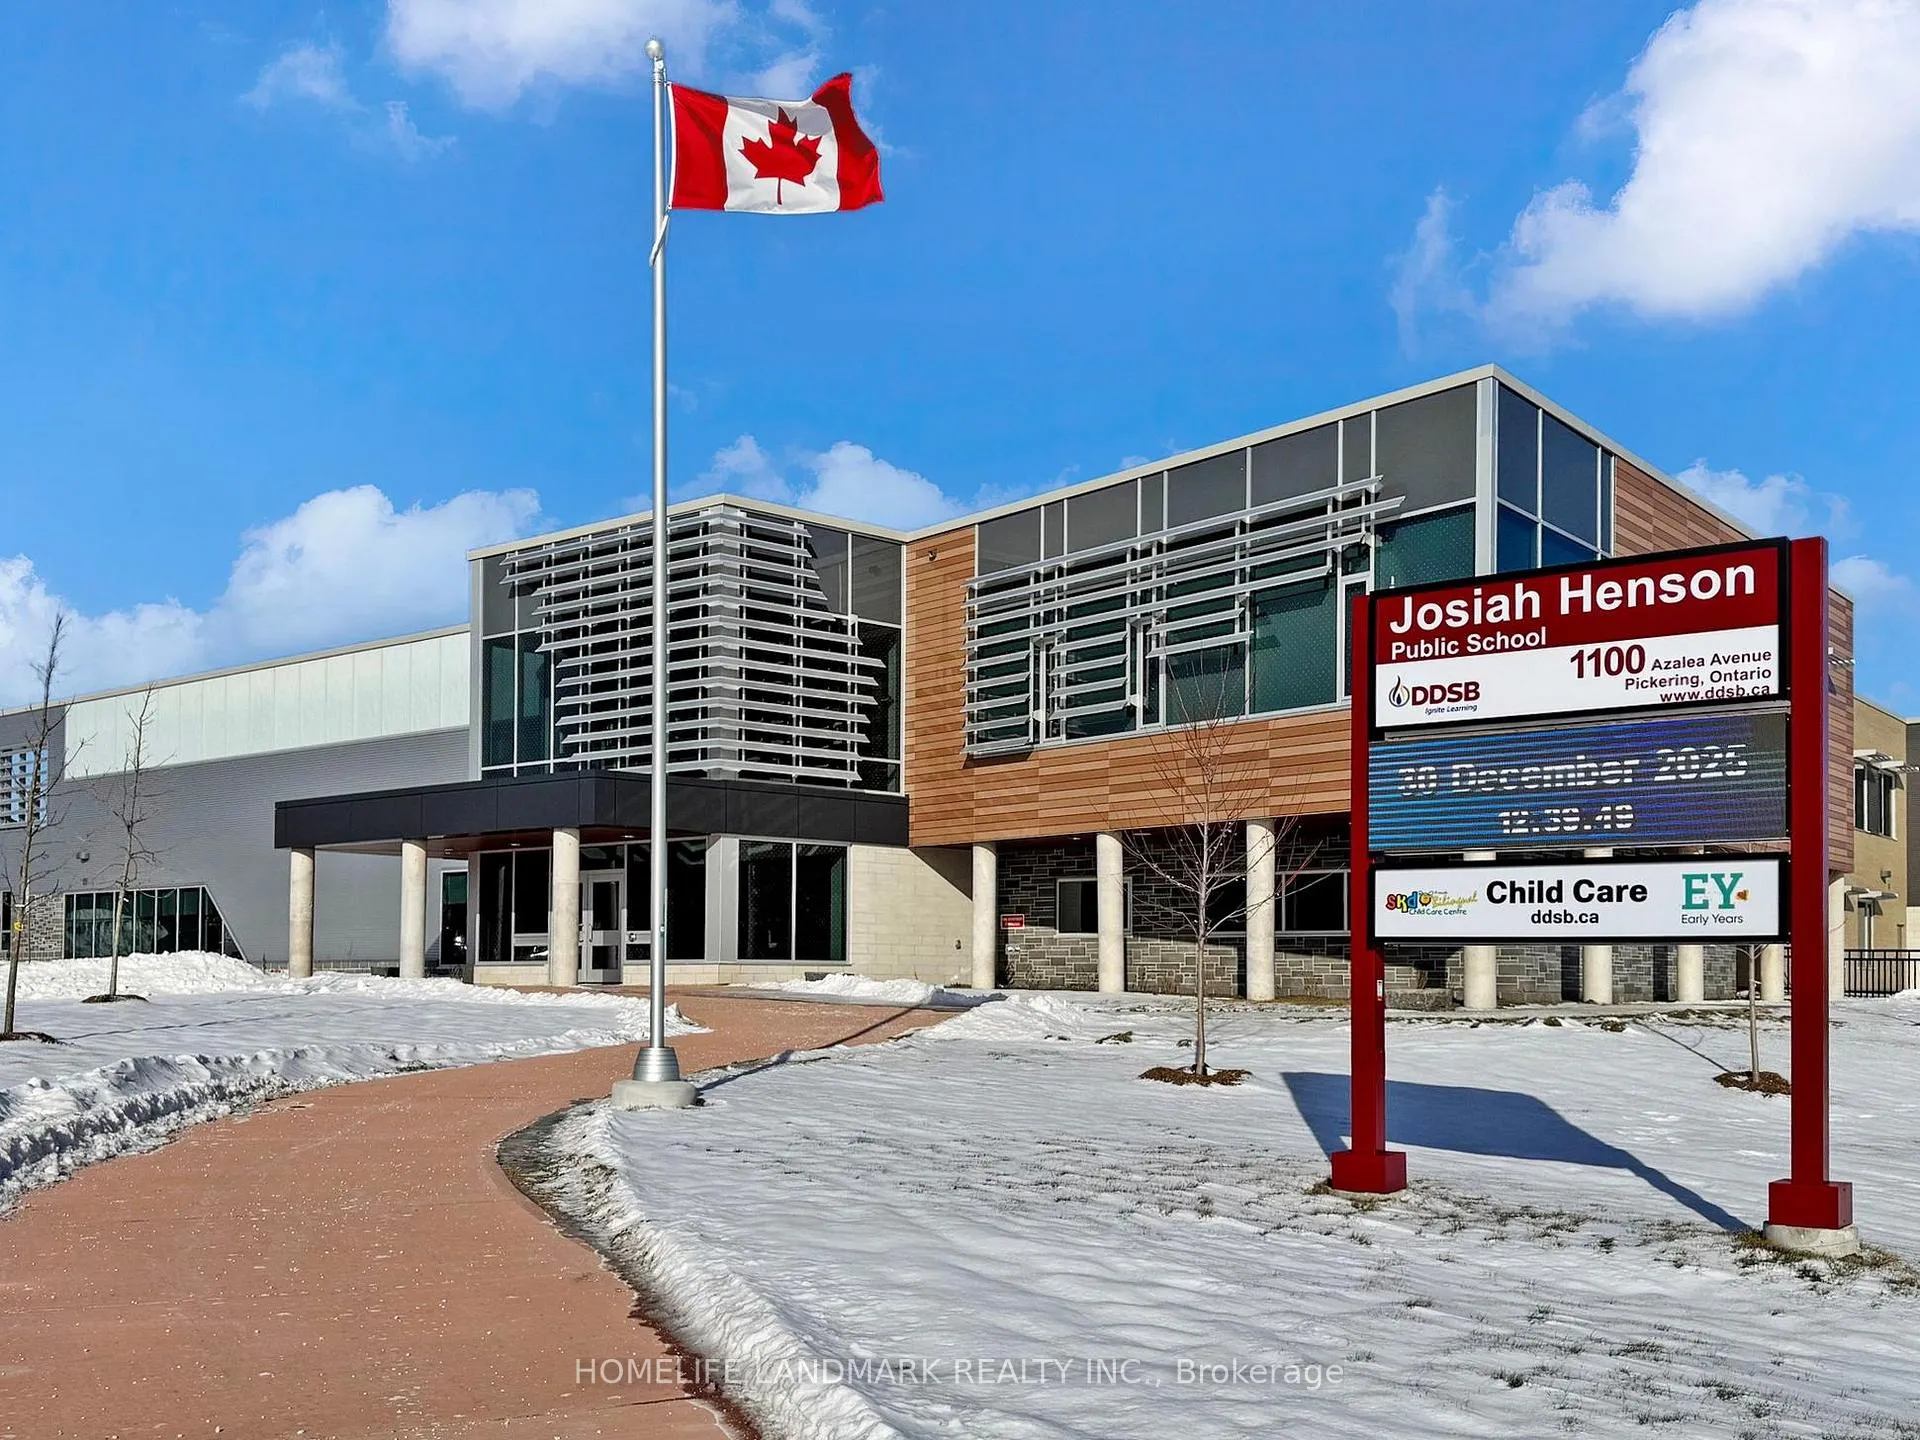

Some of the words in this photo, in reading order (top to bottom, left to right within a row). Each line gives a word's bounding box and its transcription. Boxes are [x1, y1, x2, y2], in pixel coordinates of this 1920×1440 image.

[1389, 582, 1541, 634] Josiah
[1560, 564, 1755, 615] Henson
[1391, 636, 1459, 660] Public
[1466, 626, 1546, 652] School
[1570, 644, 1646, 678] 1100
[1651, 656, 1705, 671] Azalea
[1710, 651, 1772, 666] Avenue
[1625, 674, 1704, 690] Pickering,
[1710, 667, 1772, 683] Ontario
[1411, 681, 1480, 706] DDSB
[1660, 684, 1771, 702] www.ddsb.ca
[1425, 706, 1445, 715] Ignite
[1447, 704, 1477, 713] Learning
[1451, 754, 1641, 794] December
[1486, 880, 1563, 904] Child
[1573, 879, 1648, 903] Care
[1682, 873, 1743, 909] EY
[1531, 909, 1599, 924] ddsb.ca
[1681, 914, 1709, 925] Early
[1712, 913, 1744, 924] Years
